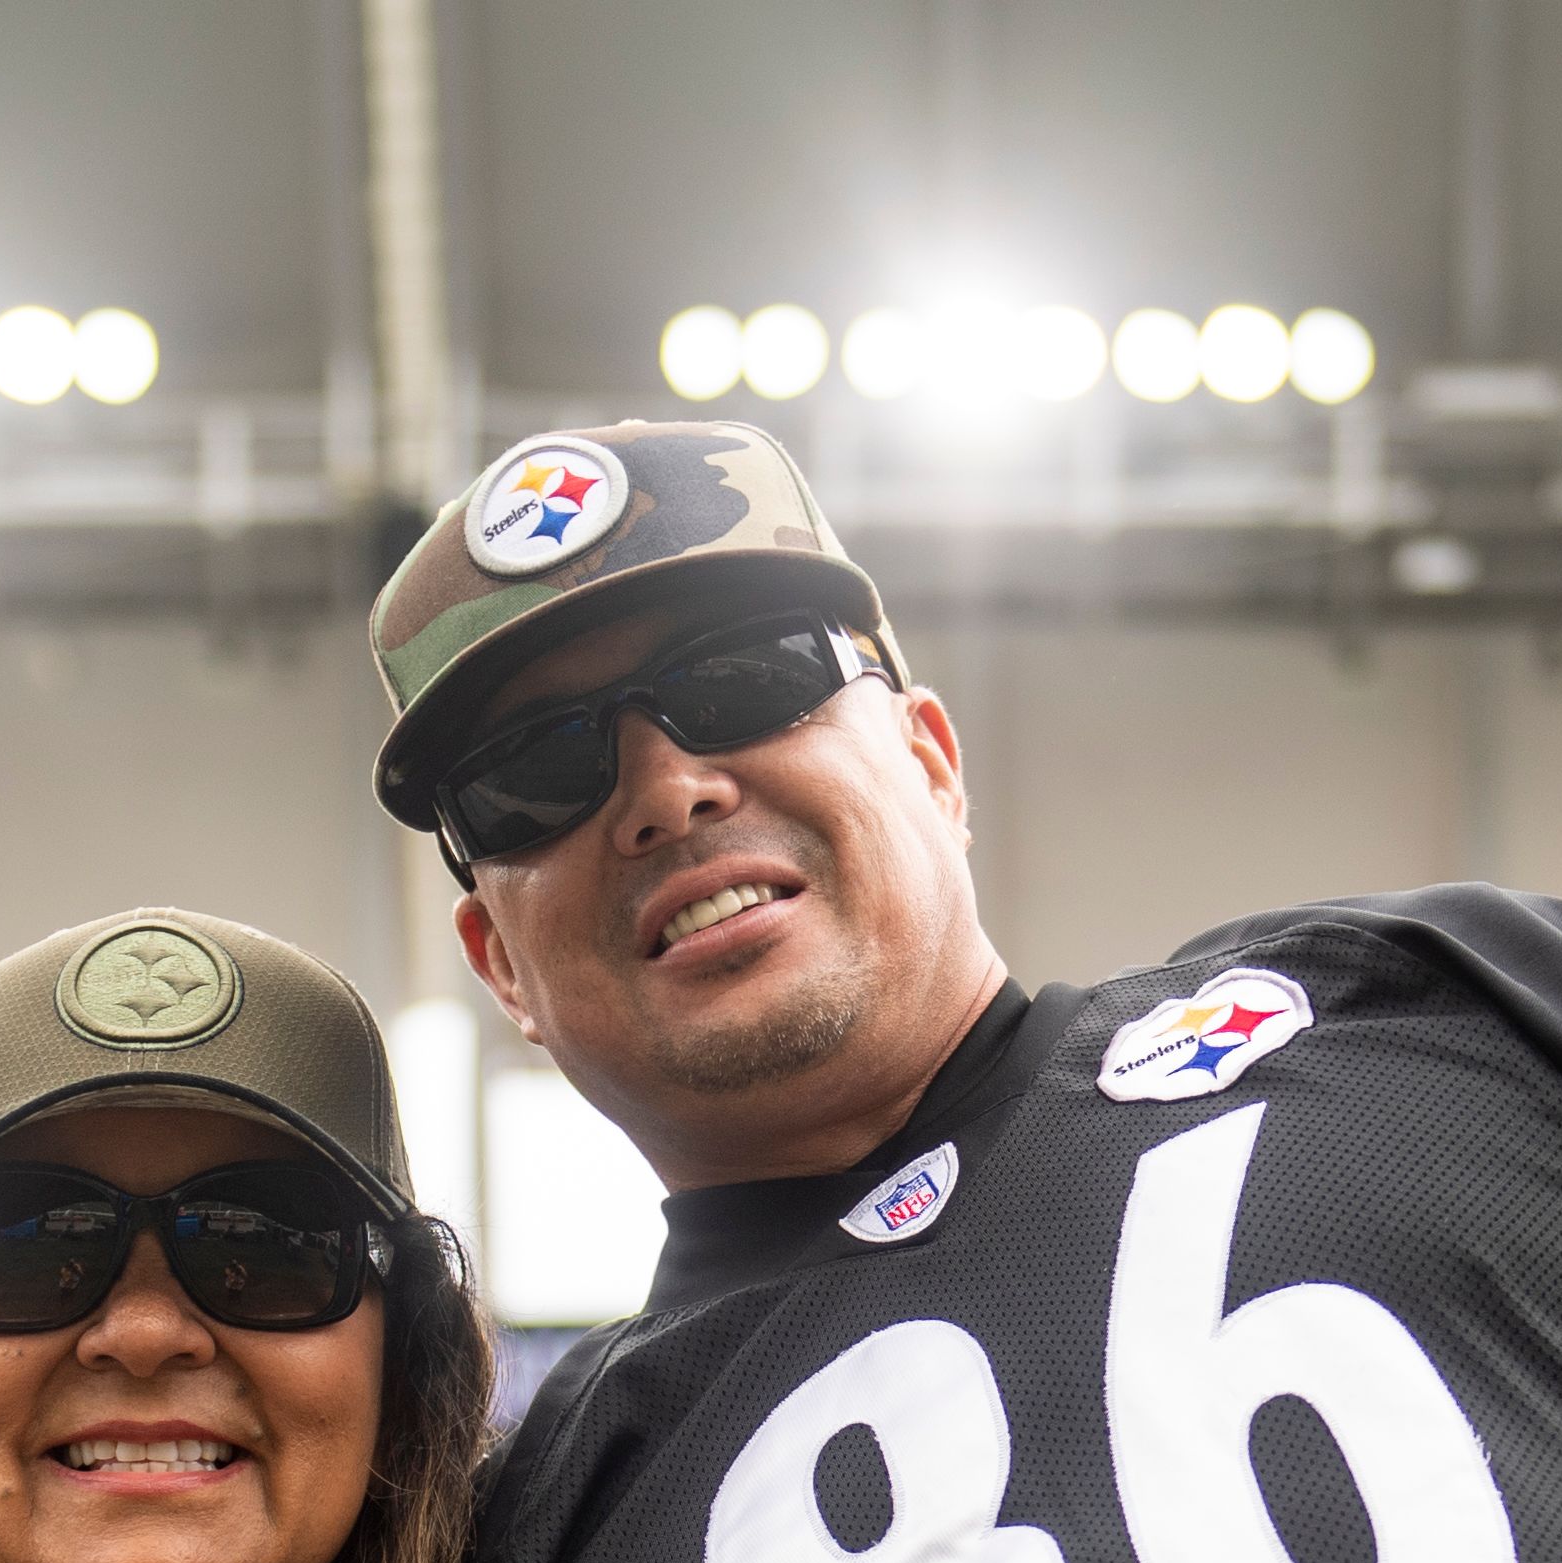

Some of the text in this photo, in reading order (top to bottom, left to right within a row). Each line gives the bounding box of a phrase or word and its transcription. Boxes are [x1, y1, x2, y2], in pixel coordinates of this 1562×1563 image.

[483, 497, 539, 543] Steelers
[1112, 1034, 1197, 1077] Steelers
[886, 1191, 934, 1227] NFL
